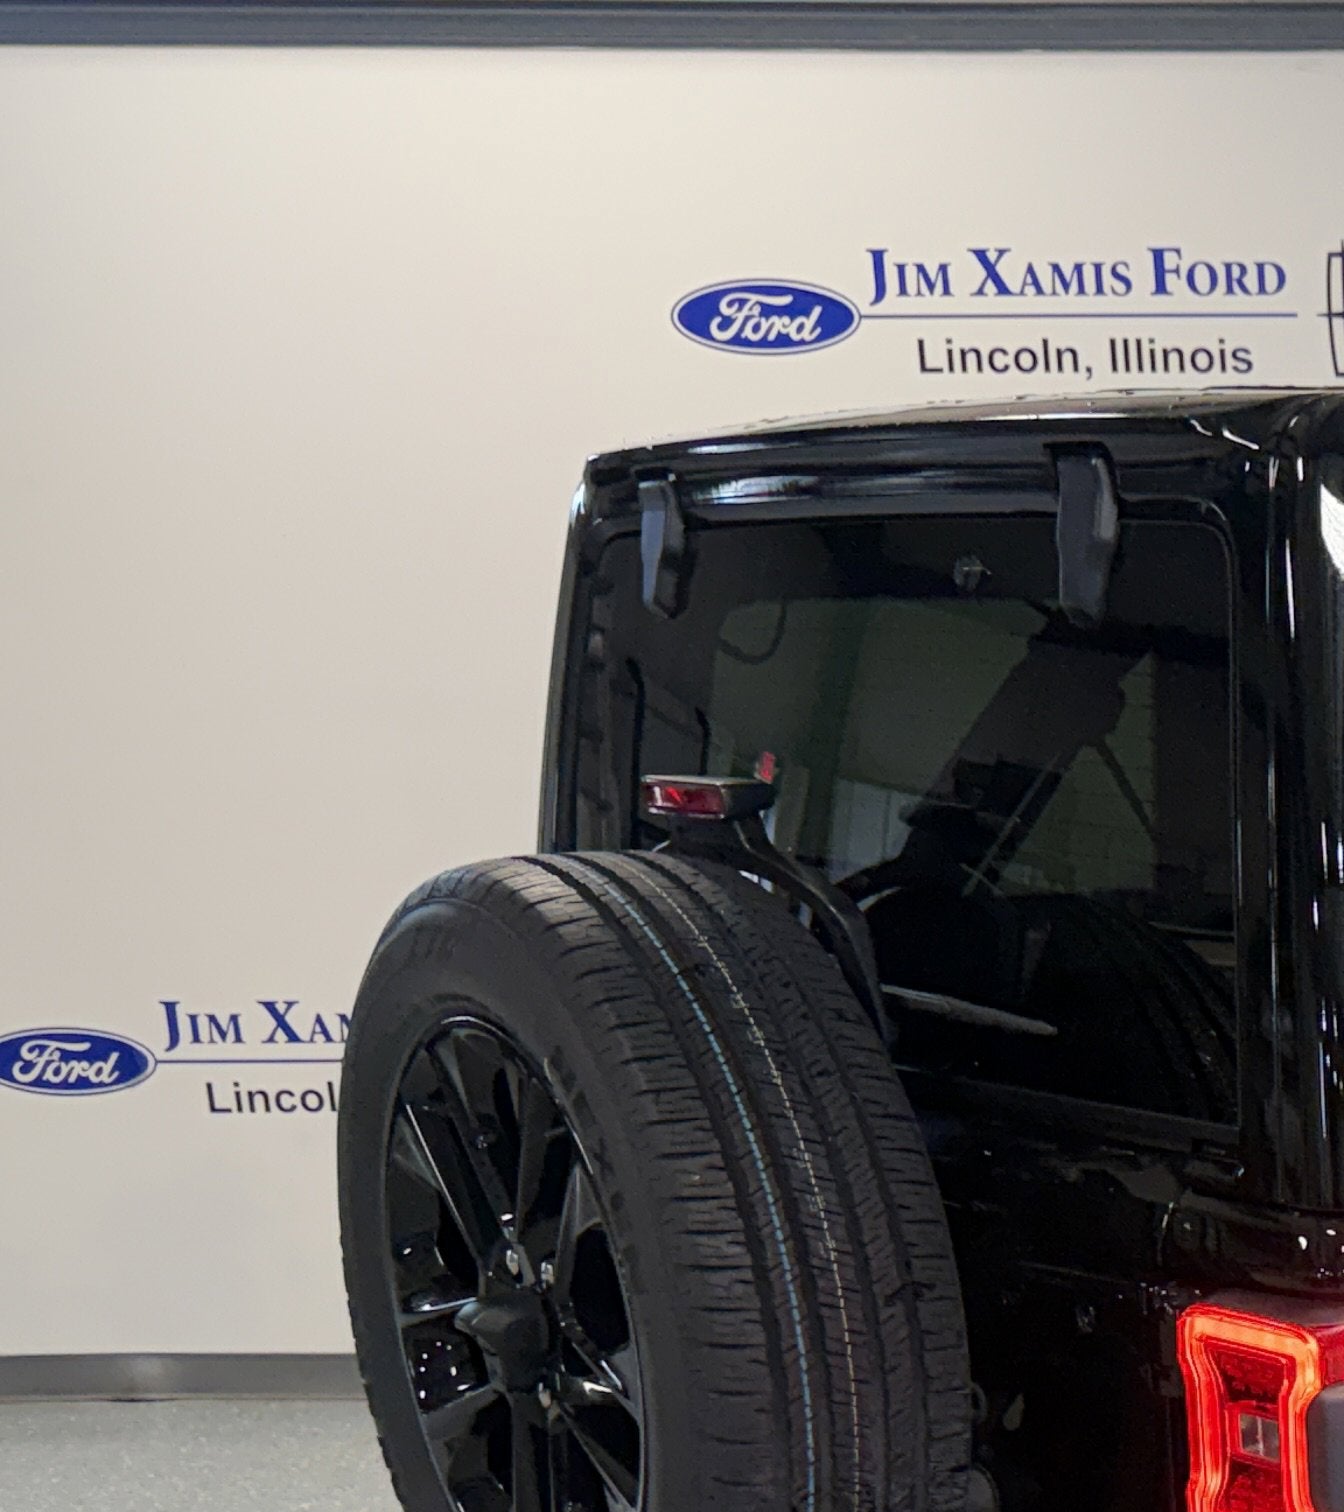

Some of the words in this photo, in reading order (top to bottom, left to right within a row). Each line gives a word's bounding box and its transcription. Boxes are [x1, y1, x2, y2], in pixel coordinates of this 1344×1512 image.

[865, 248, 952, 306] JIM
[966, 248, 1133, 297] XAMIS
[1148, 248, 1287, 297] FORD
[709, 291, 822, 344] Ford
[918, 337, 1094, 380] Lincoln,
[1109, 337, 1254, 374] Illinois
[159, 1000, 245, 1052] JIM
[12, 1039, 120, 1084] Ford
[206, 1081, 338, 1113] Lincol
